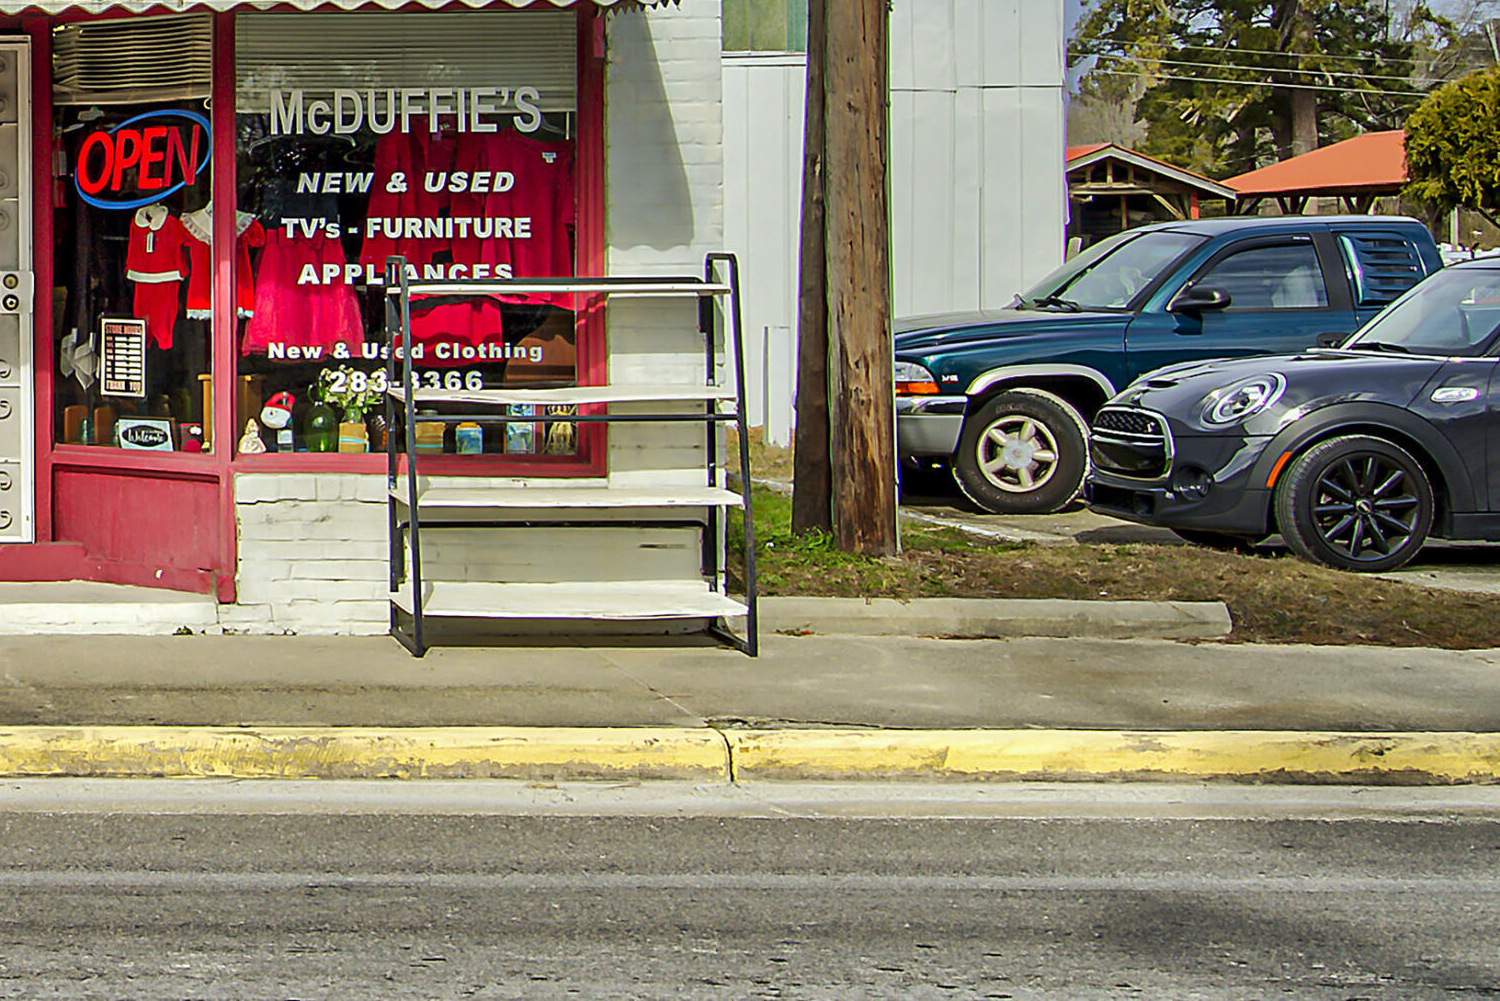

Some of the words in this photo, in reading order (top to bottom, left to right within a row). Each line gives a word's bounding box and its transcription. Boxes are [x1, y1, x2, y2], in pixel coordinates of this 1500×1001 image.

[270, 86, 542, 135] McDUFFIE'S
[77, 124, 200, 195] OPEN
[296, 171, 374, 194] NEW
[385, 171, 408, 194] &
[424, 171, 515, 193] USED
[281, 217, 340, 238] TV's
[366, 217, 531, 238] FURNITURE
[268, 343, 322, 359] New
[332, 343, 351, 359] &
[435, 342, 543, 362] Clothing
